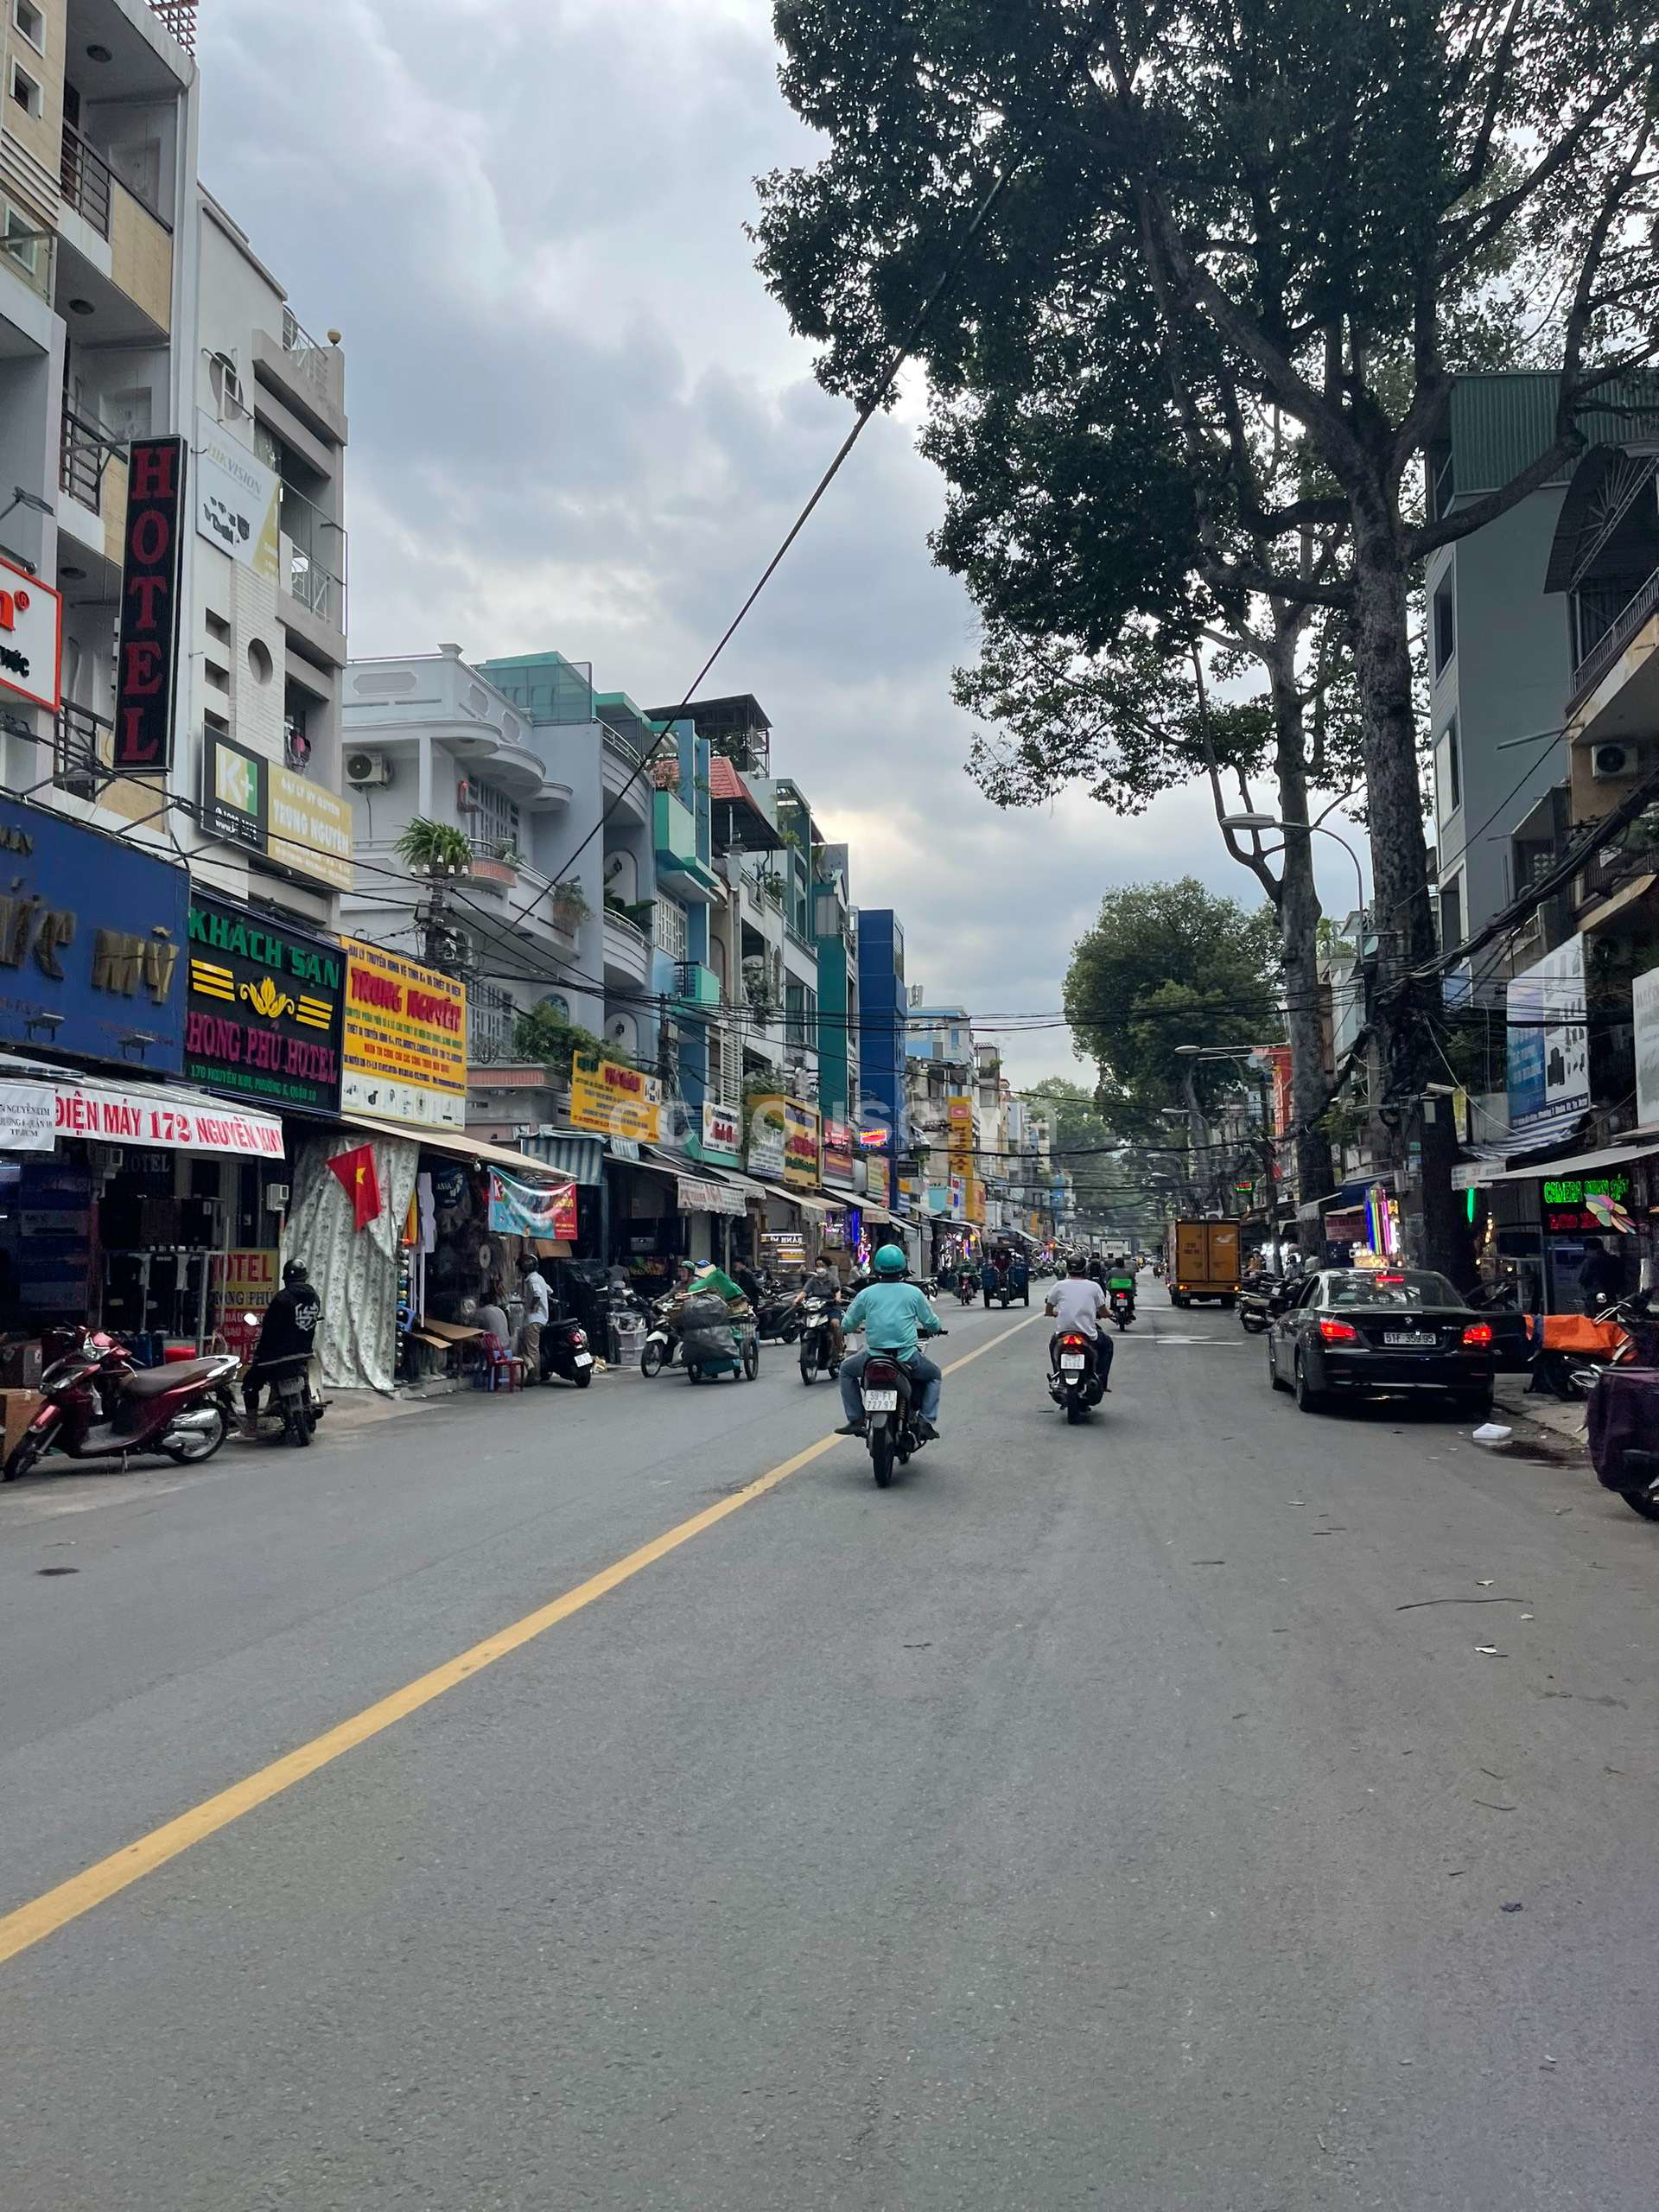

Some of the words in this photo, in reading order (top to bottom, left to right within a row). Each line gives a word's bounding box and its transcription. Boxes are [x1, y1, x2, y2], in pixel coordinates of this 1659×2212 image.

[122, 446, 175, 762] HOTEL
[188, 907, 283, 969] KHÁCH
[289, 946, 340, 989] SẠN
[246, 1020, 283, 1071] PHÚ
[285, 1038, 338, 1084] HOTEL
[103, 1097, 142, 1137] MÁY
[149, 1110, 193, 1143] 172
